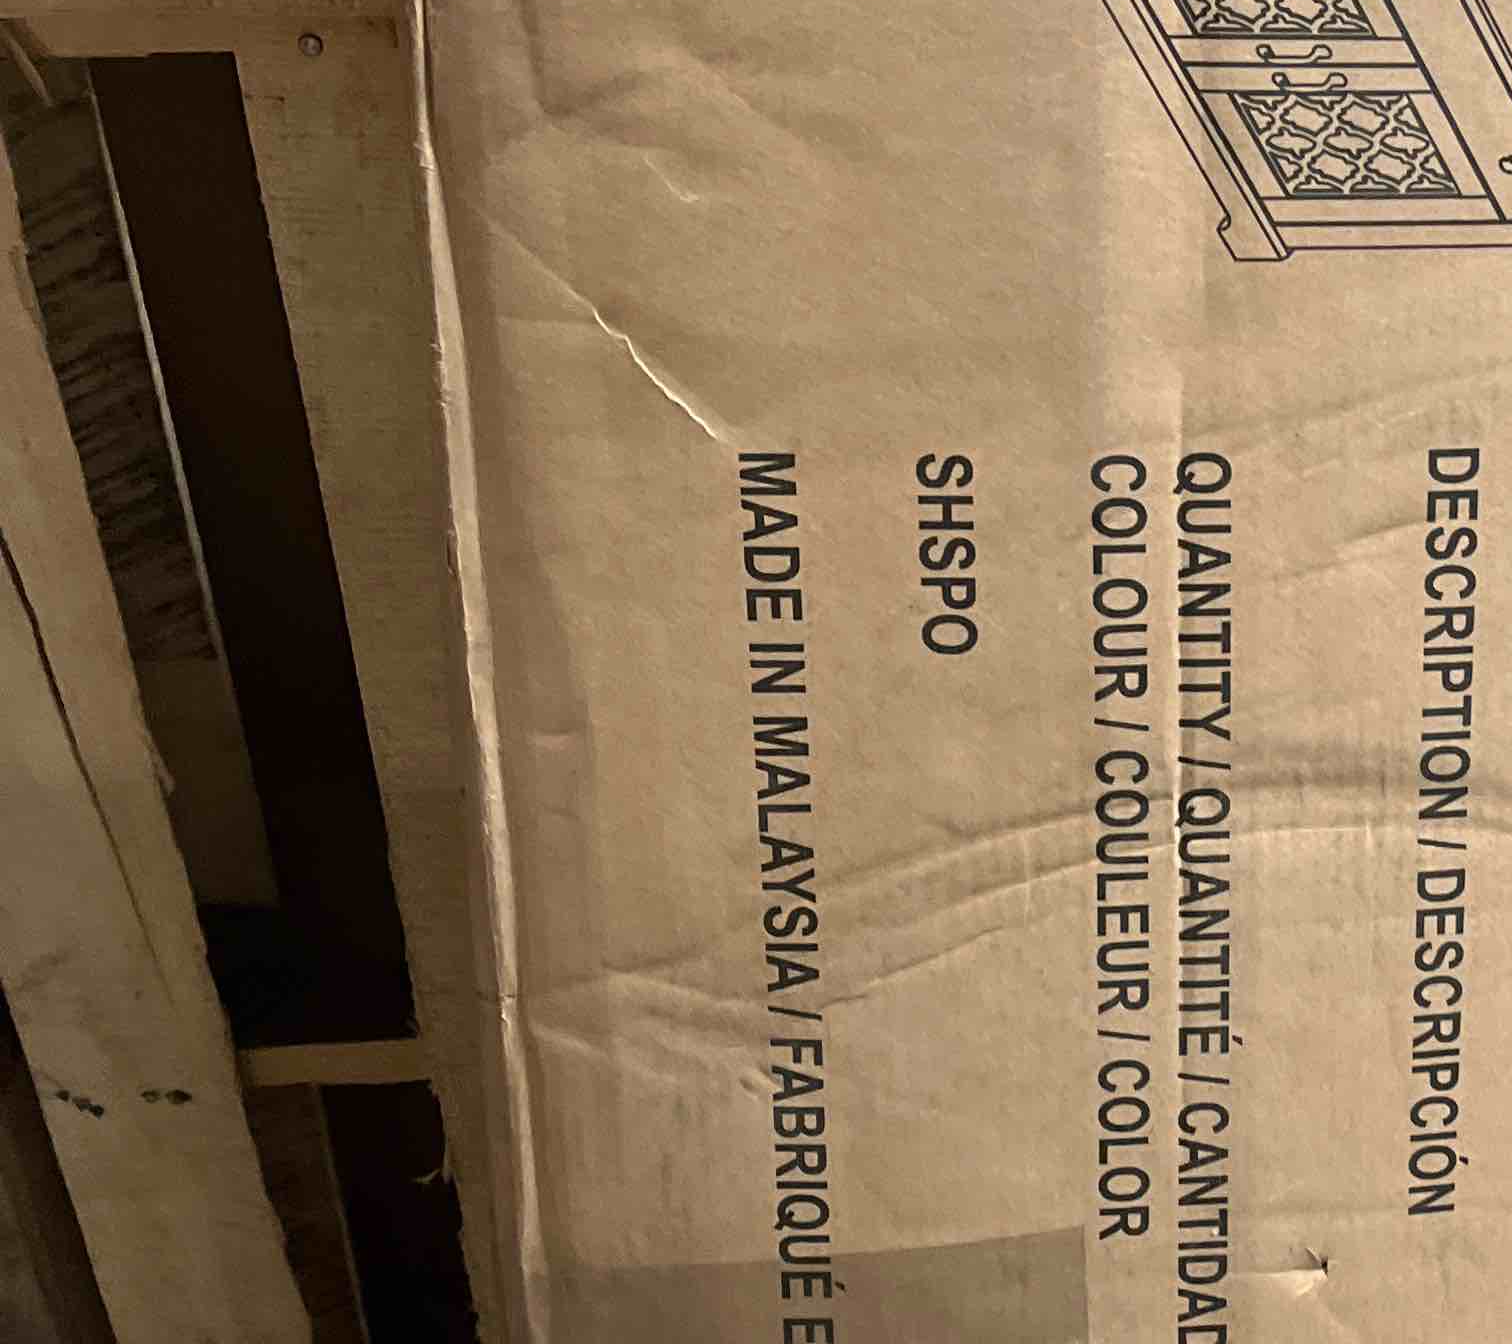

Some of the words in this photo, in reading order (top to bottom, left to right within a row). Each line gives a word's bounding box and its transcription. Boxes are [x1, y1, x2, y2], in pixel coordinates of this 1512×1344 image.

[738, 453, 803, 622] MADE
[915, 453, 979, 655] SHSPO
[1090, 455, 1149, 703] COLOUR
[1172, 452, 1233, 741] QUANTITY
[748, 642, 807, 694] IN
[1093, 717, 1150, 732] /
[1418, 447, 1480, 821] DESCRIPTION
[752, 715, 820, 993] MALAYSIA
[1177, 755, 1232, 771] /
[1417, 838, 1467, 851] /
[1094, 750, 1150, 1015] COULEUR
[1174, 787, 1243, 1057] QUANTITÉ
[767, 1005, 823, 1022] /
[1097, 1029, 1151, 1042] /
[1177, 1072, 1230, 1086] /
[1407, 868, 1469, 1216] DESCRIPCIÓN
[769, 1037, 846, 1300] FABRIQUÉ
[1097, 1059, 1151, 1241] COLOR
